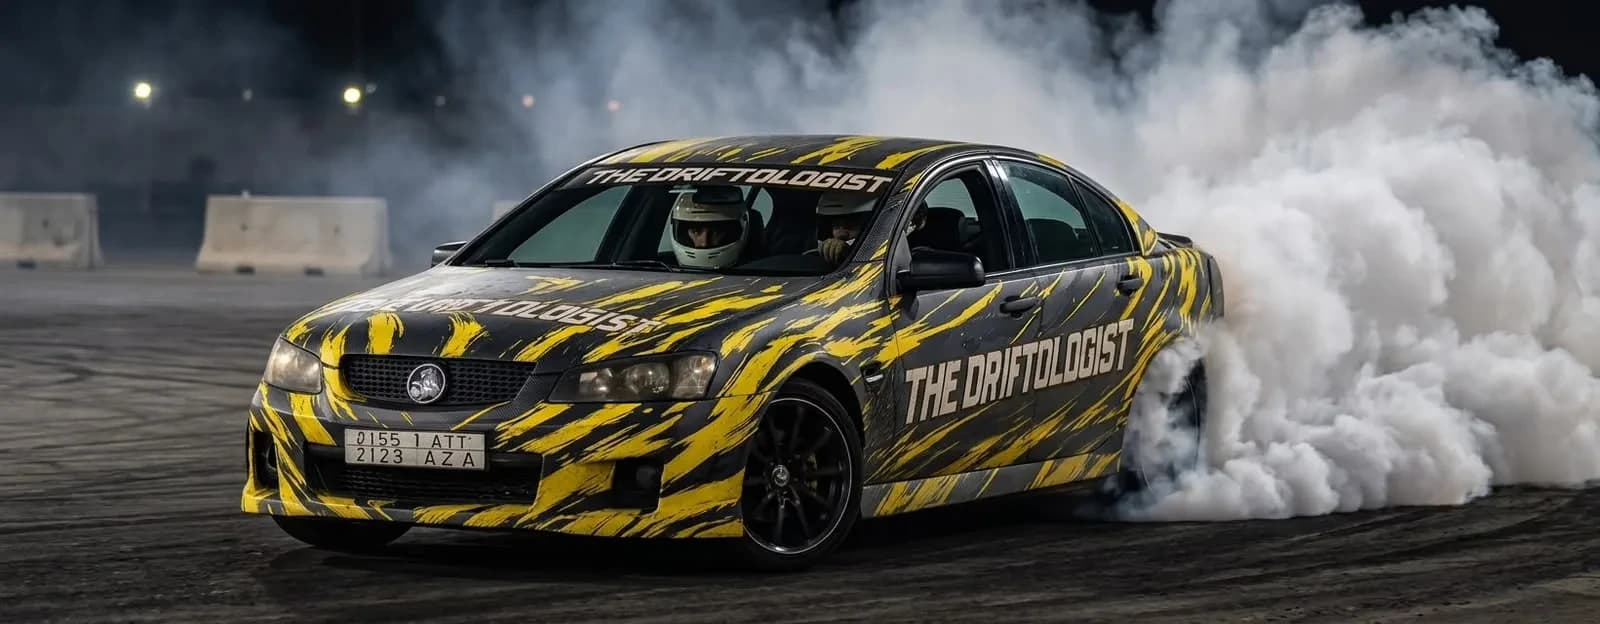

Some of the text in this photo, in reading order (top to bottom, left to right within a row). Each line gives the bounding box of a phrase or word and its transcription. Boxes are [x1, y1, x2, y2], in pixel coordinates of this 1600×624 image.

[586, 168, 893, 193] THE DRIFTOLOGIST
[905, 319, 1134, 425] THE DRIFTOLOGIST
[356, 447, 404, 464] 2123
